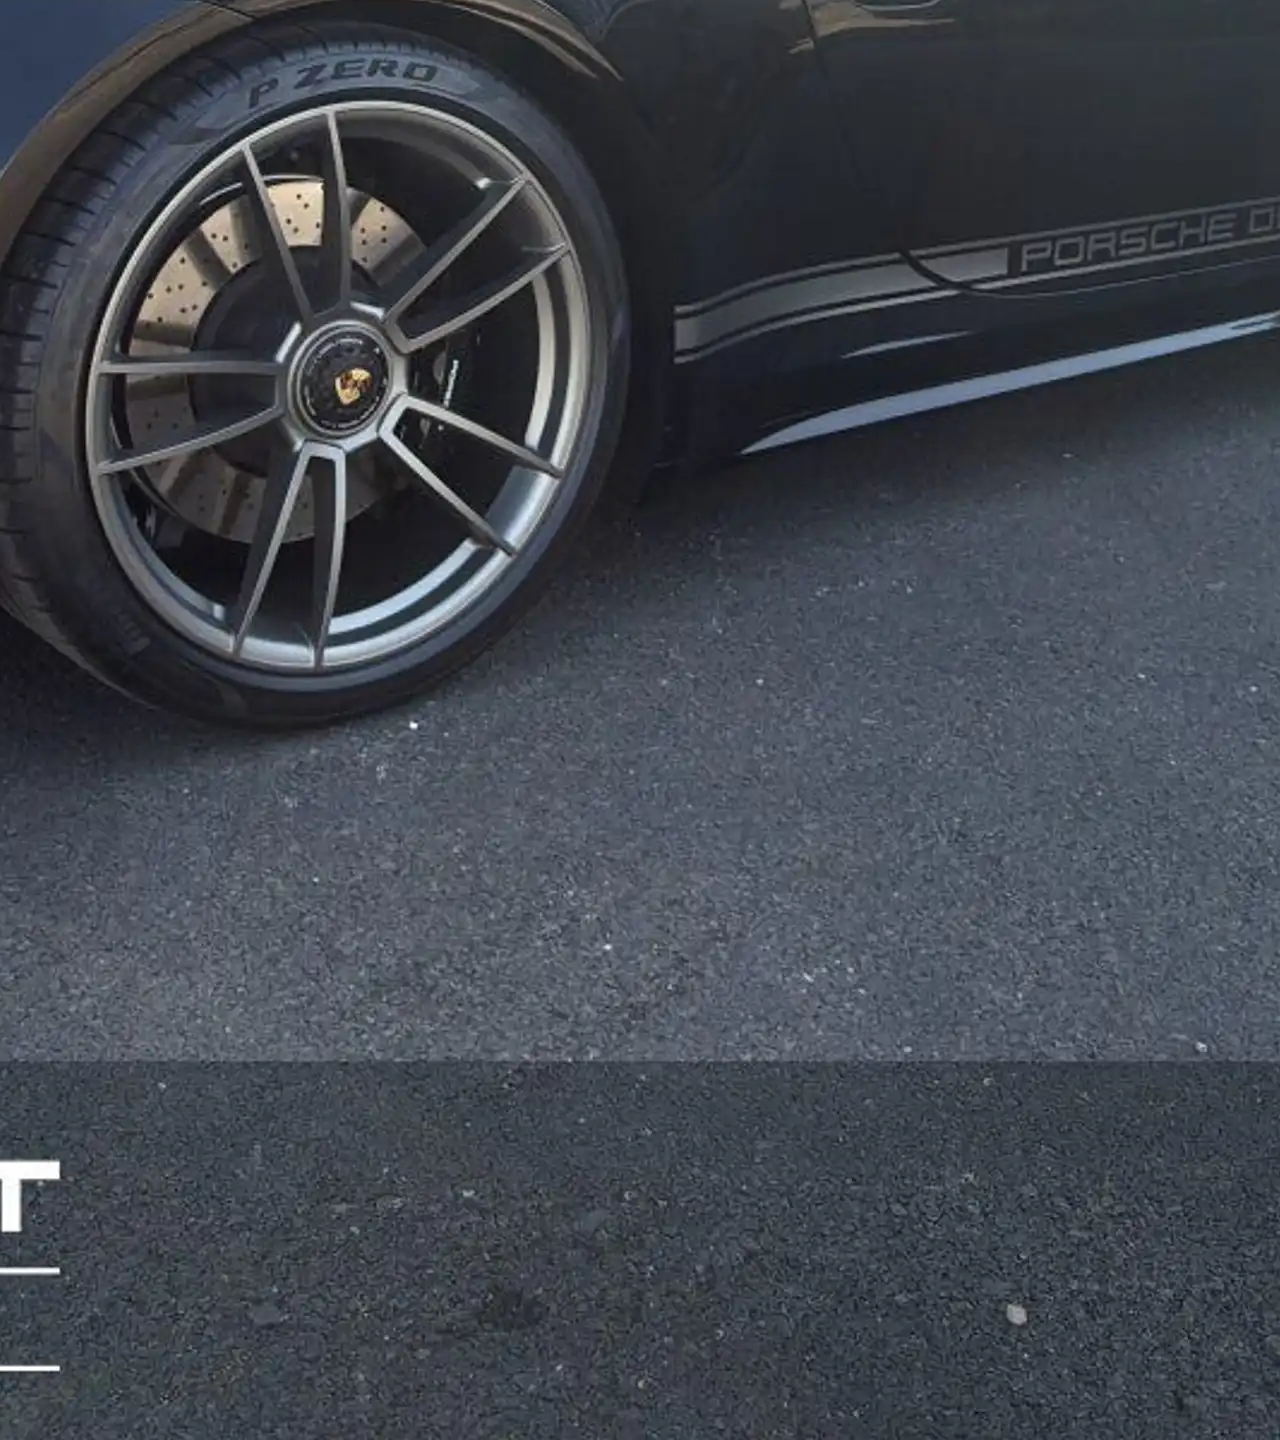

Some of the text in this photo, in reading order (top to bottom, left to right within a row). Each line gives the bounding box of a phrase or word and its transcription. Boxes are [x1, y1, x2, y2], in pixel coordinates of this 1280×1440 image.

[249, 58, 439, 108] P ZERO
[1022, 214, 1236, 271] PORSCHE
